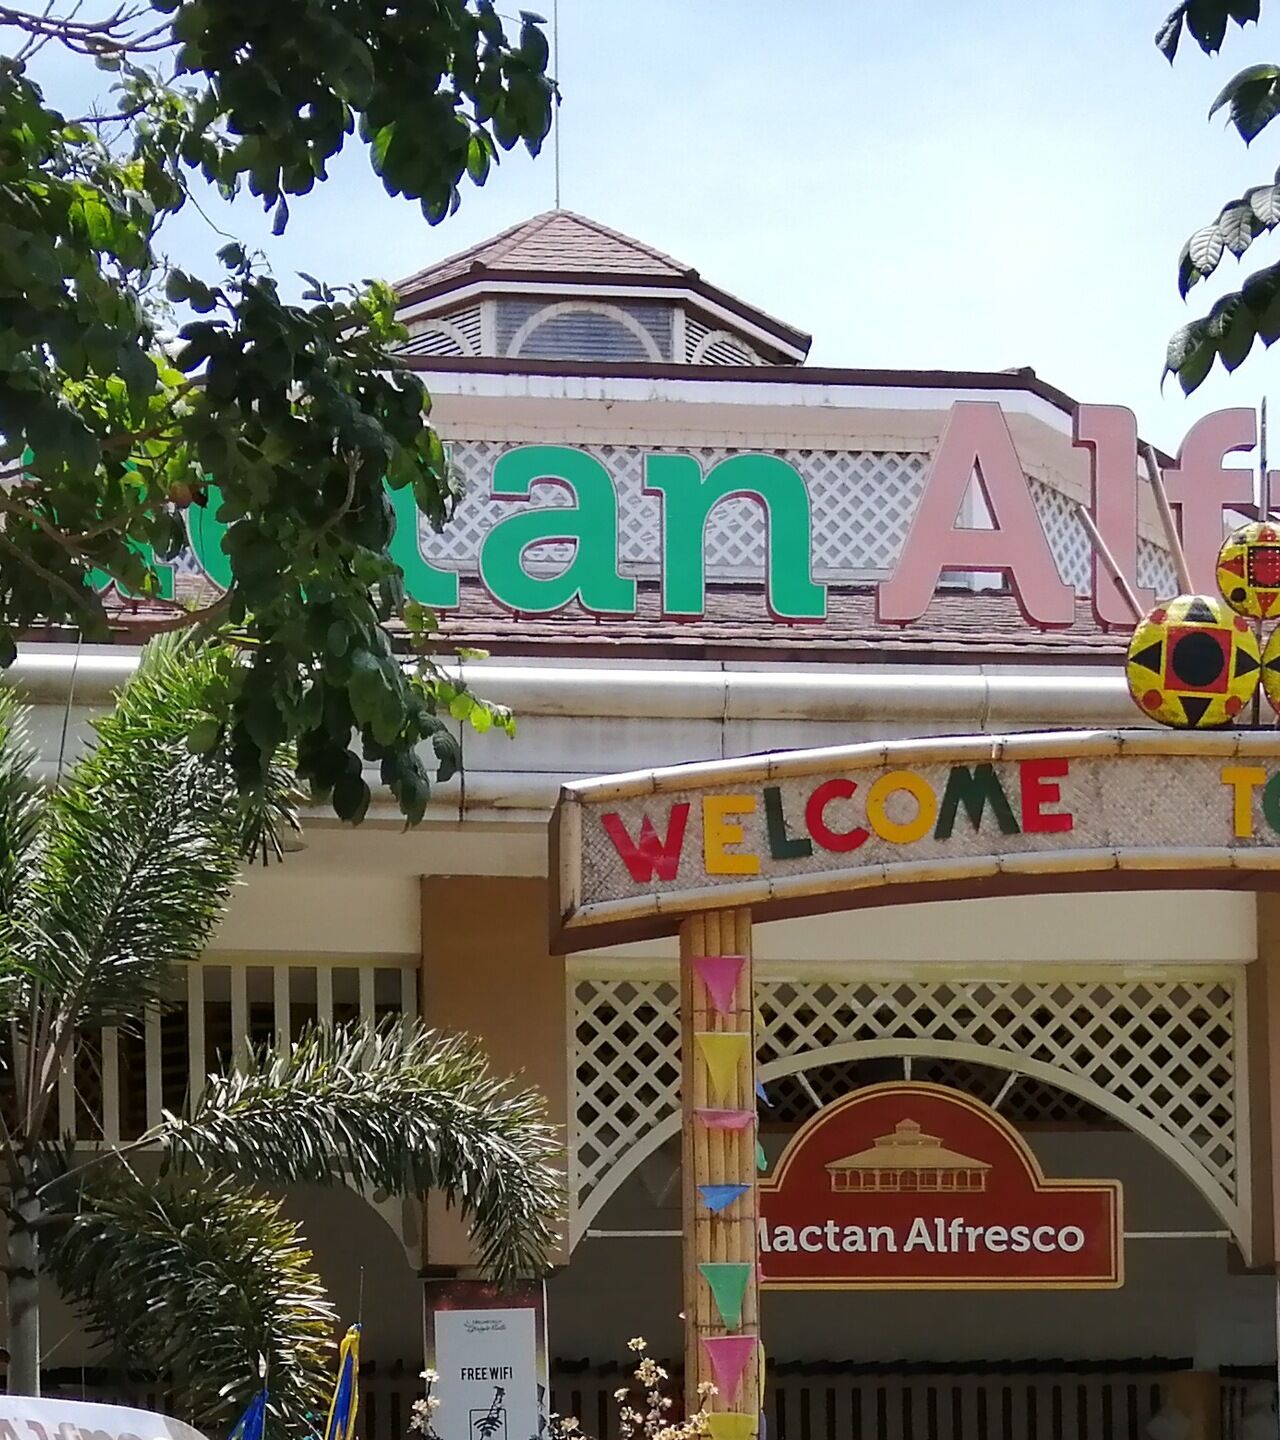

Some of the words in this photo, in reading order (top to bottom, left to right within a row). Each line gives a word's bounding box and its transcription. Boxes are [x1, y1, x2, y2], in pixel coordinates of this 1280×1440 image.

[601, 758, 1074, 883] WELCOME
[903, 1216, 1086, 1253] Alfresco
[461, 1367, 488, 1380] FREE
[489, 1366, 513, 1380] WIFI
